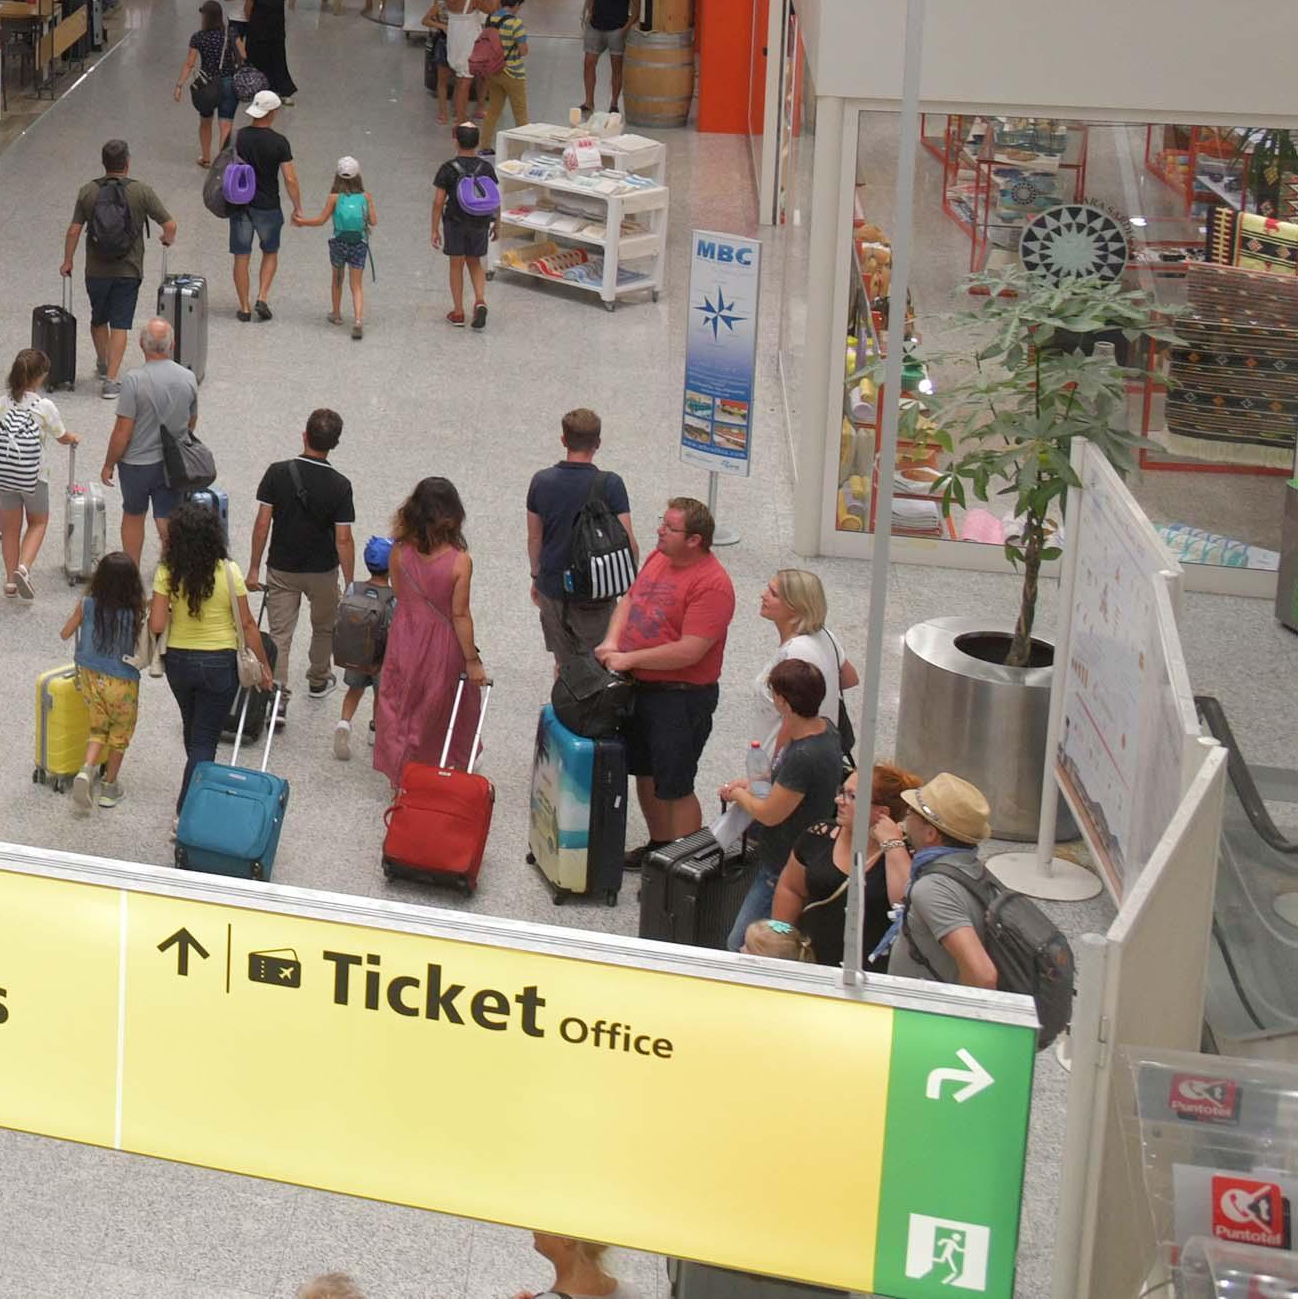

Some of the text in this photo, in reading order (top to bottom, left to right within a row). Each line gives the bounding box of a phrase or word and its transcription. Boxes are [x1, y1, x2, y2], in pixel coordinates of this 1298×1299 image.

[696, 238, 753, 266] MBC
[322, 949, 675, 1060] Ticket Office
[1171, 1099, 1232, 1118] Puntotel
[1214, 1224, 1283, 1246] Puntotel
